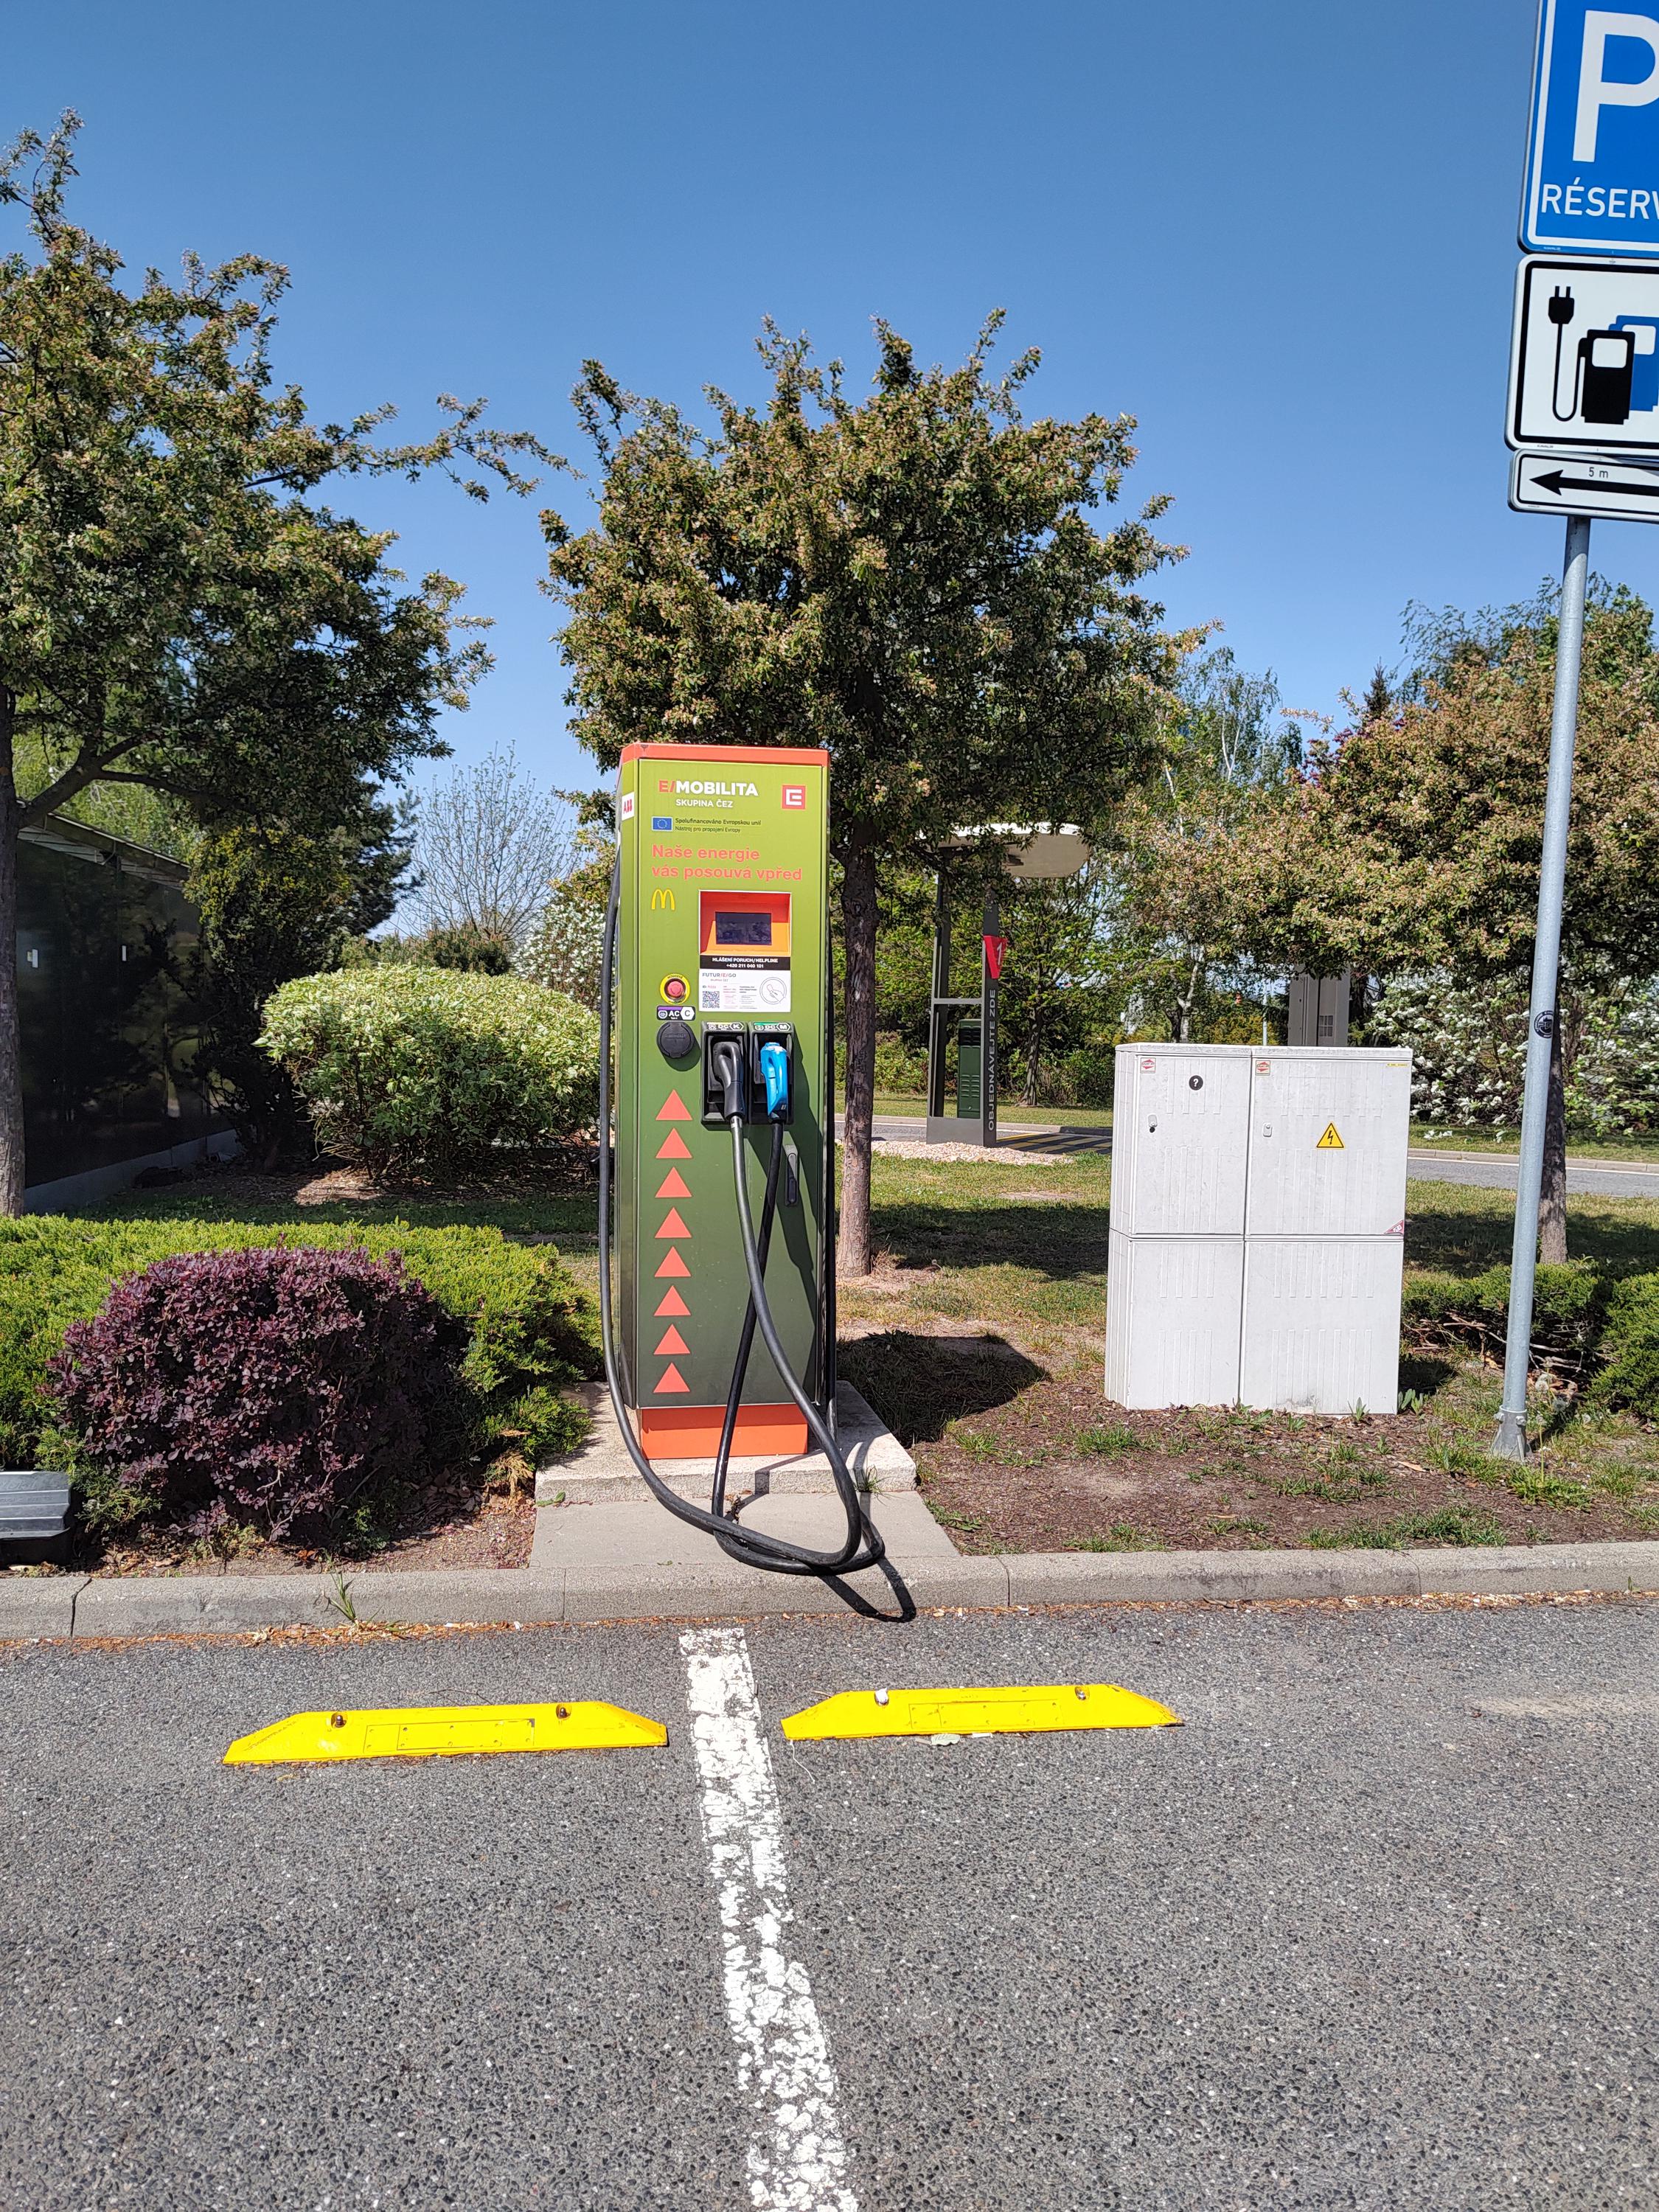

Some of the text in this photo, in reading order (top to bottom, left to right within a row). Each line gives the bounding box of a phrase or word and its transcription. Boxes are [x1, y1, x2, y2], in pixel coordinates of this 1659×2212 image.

[1573, 10, 1659, 162] P
[1588, 467, 1609, 479] 5 m
[675, 799, 734, 808] SKUPINA ČEZ
[652, 844, 759, 862] Naše energie
[652, 864, 802, 882] vás posouvá vpřed
